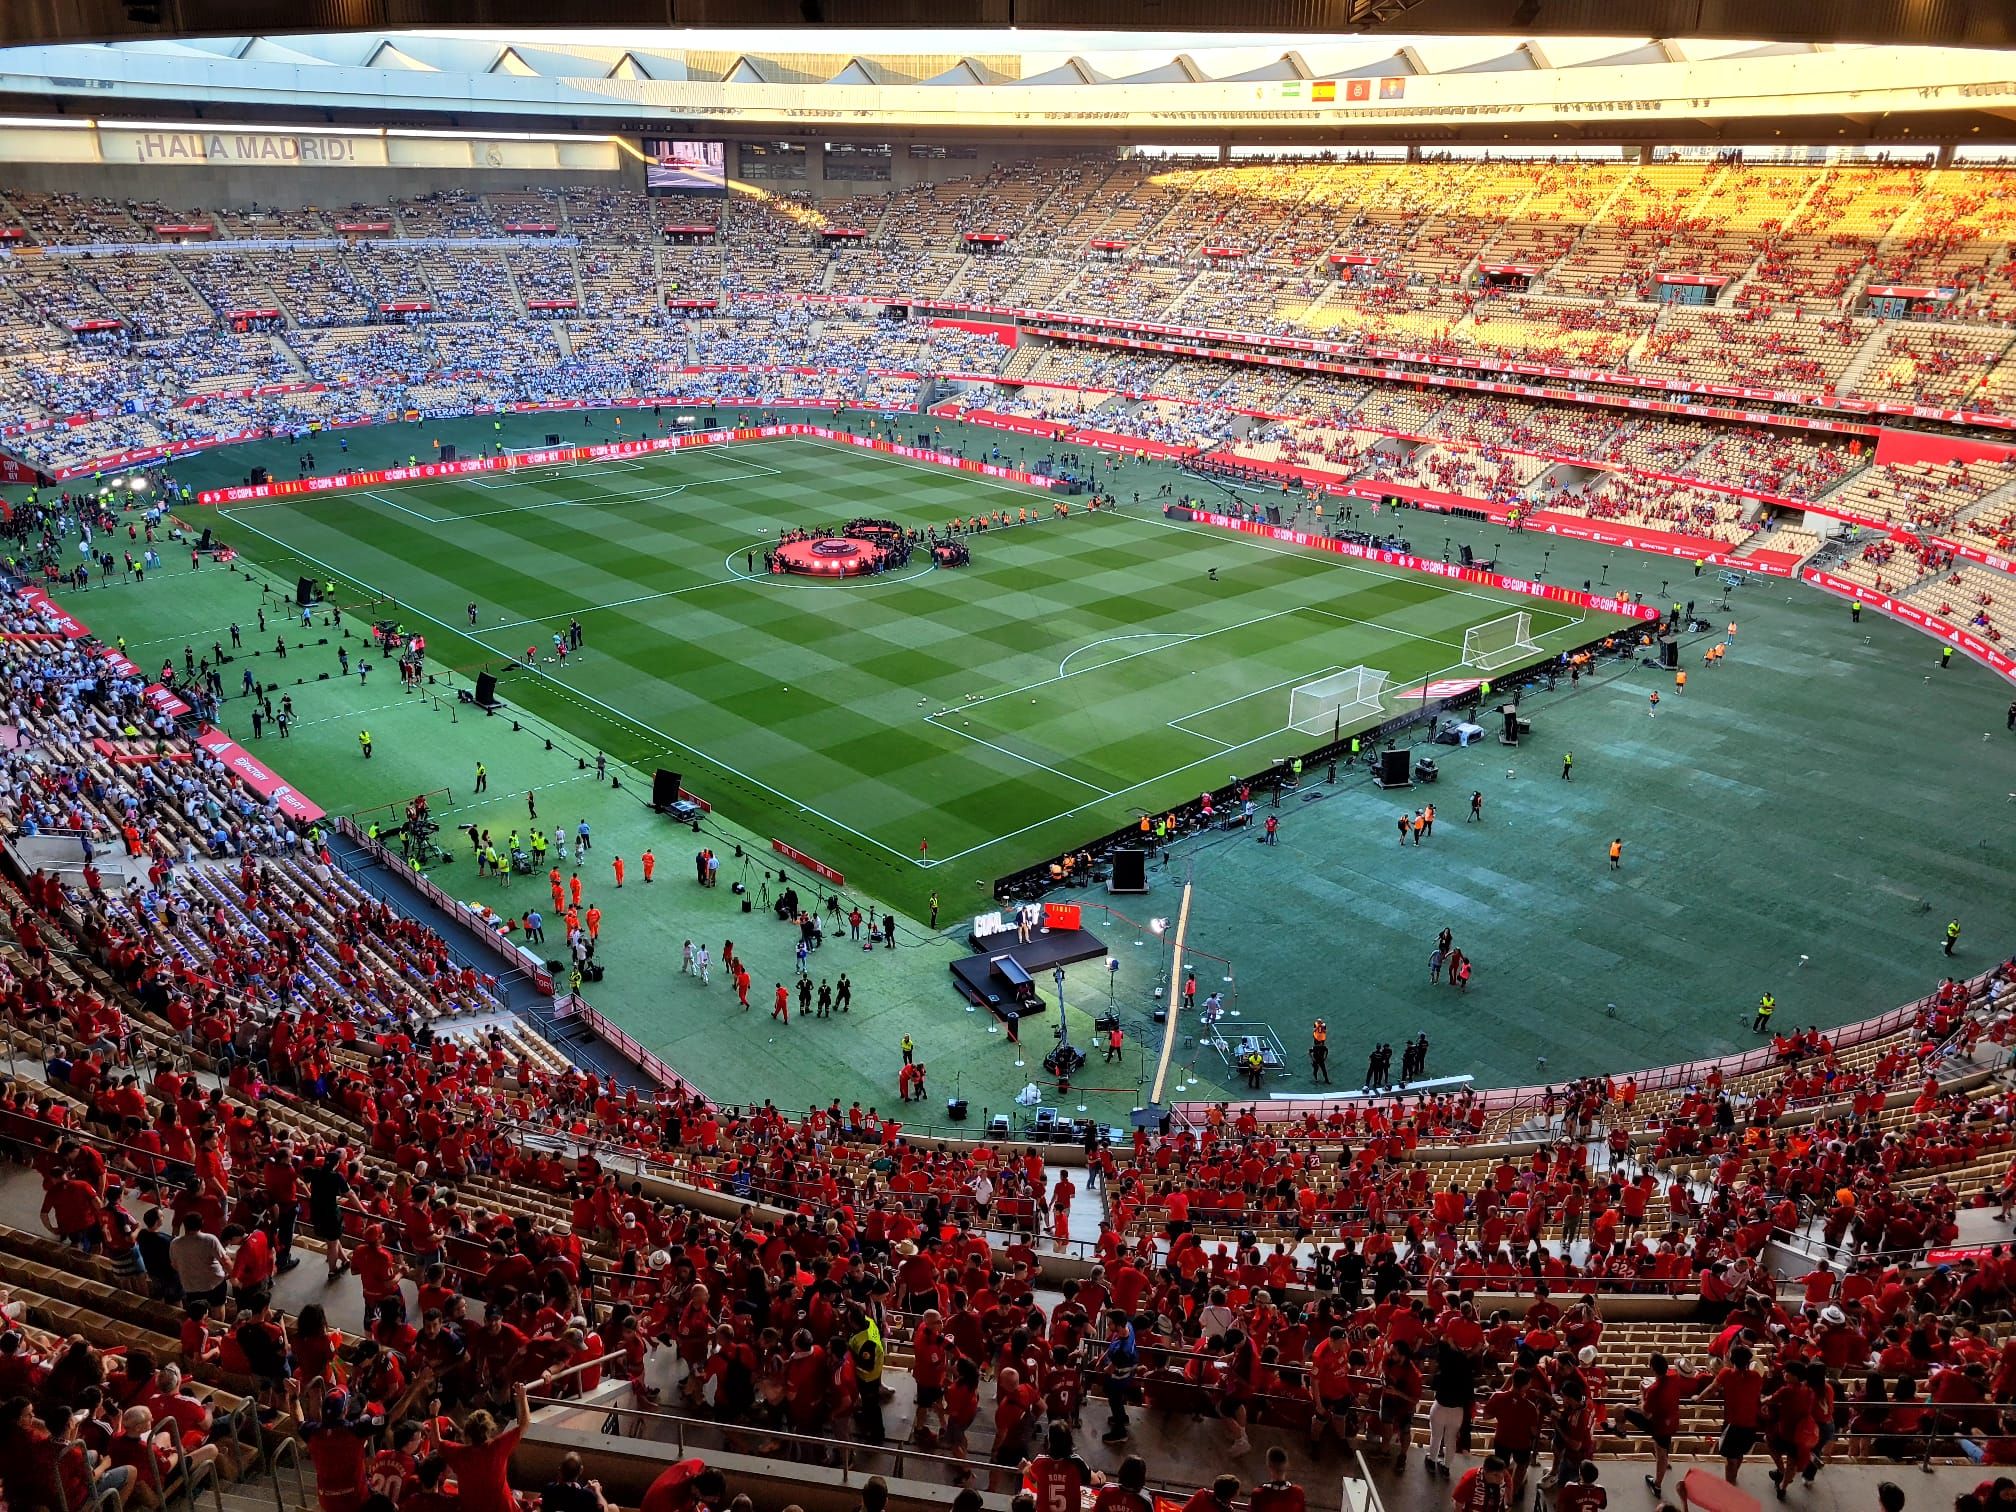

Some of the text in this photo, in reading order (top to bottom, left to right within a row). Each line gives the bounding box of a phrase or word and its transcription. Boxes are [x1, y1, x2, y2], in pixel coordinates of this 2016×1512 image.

[135, 134, 355, 162] ¡HALA MADRID!
[419, 406, 473, 418] VETERANOS
[3, 460, 19, 472] COPA
[8, 472, 18, 481] REY
[1466, 569, 1495, 586] FINAL
[1551, 587, 1583, 605] FINAL
[283, 793, 306, 810] SEAT
[866, 1119, 875, 1129] 10
[1310, 1157, 1320, 1168] 23
[1321, 1263, 1332, 1276] 12
[1060, 1390, 1069, 1406] 9
[1050, 1484, 1067, 1512] 5
